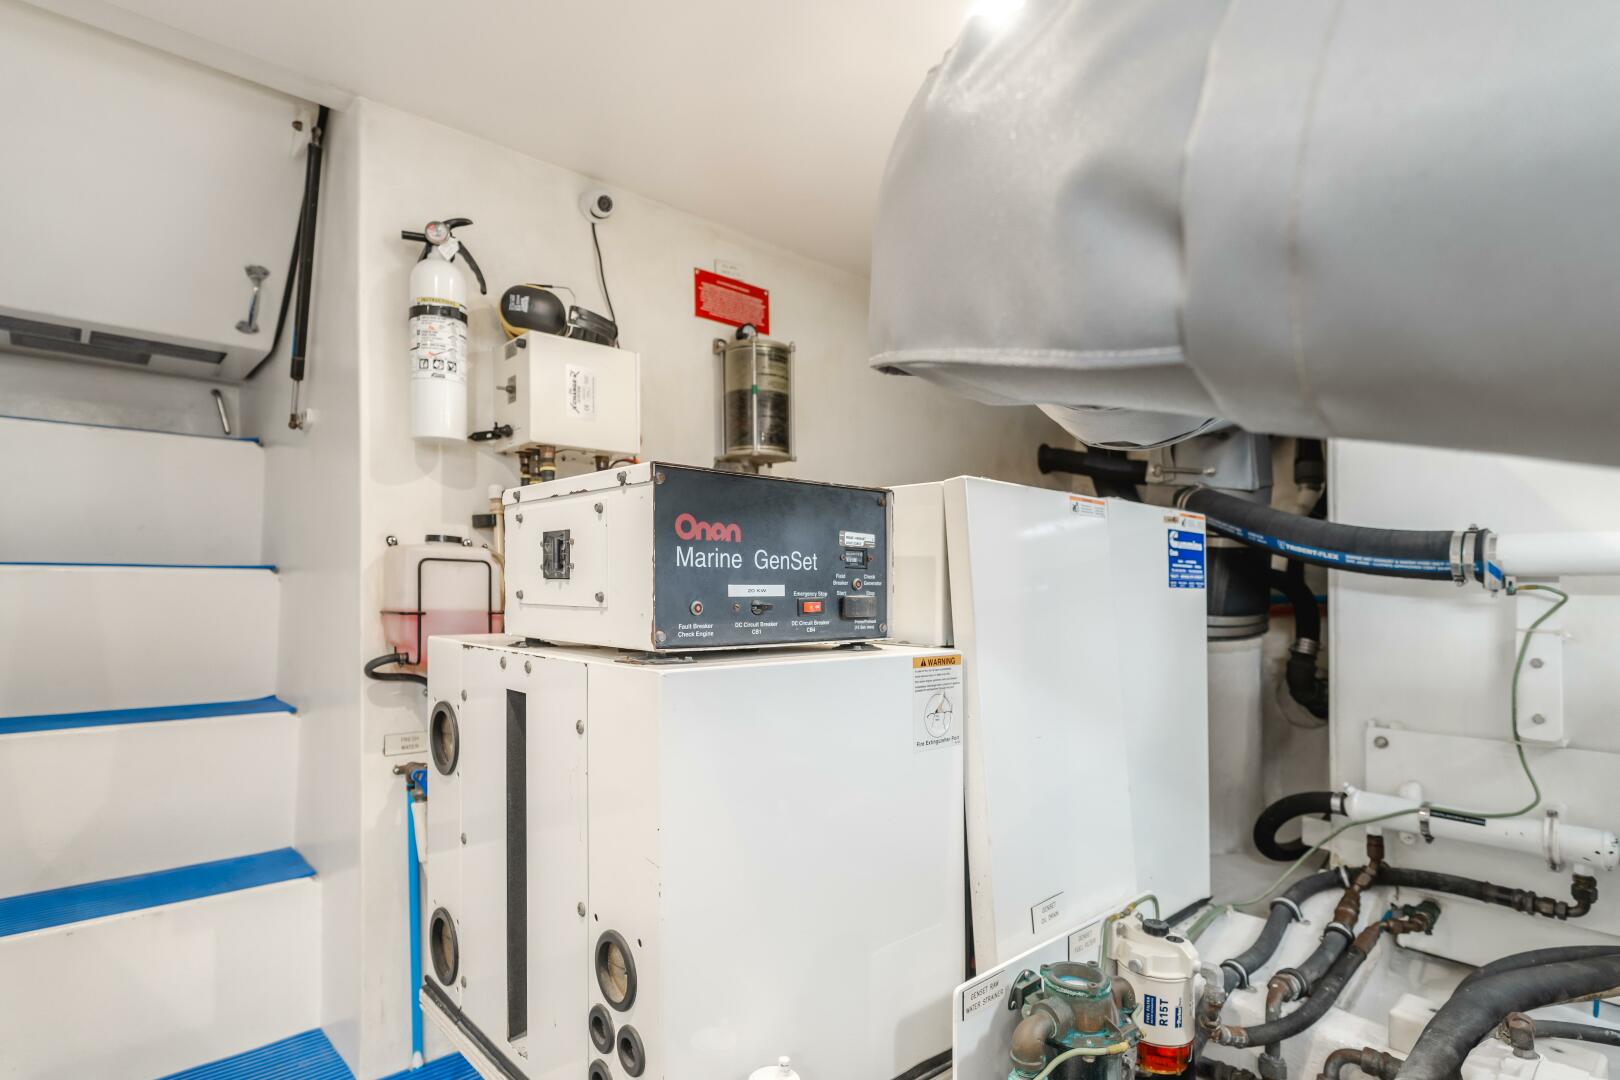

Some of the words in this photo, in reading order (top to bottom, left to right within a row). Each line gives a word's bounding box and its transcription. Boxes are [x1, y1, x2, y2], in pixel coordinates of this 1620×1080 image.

[674, 513, 742, 543] Onan
[676, 545, 743, 569] Marine
[754, 549, 818, 571] GenSet
[793, 590, 817, 598] Emergency
[927, 657, 956, 666] WARNING
[970, 985, 988, 1001] GENSET
[966, 1001, 981, 1013] WATER
[1159, 998, 1169, 1026] R15T
